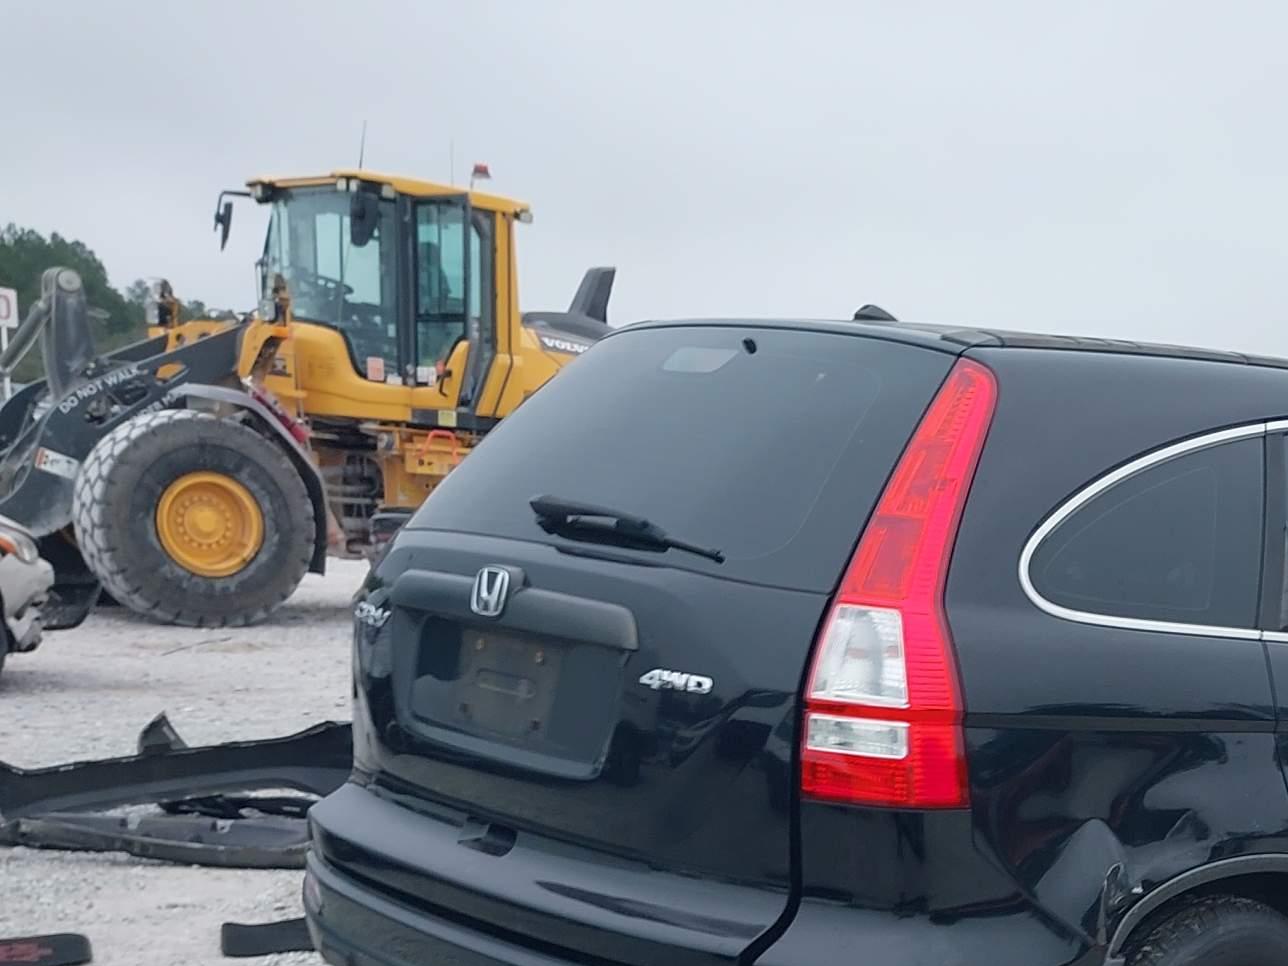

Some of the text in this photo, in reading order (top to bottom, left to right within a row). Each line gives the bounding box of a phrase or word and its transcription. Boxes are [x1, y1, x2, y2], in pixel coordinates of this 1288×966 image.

[541, 337, 589, 353] VOLV
[59, 366, 139, 415] DO NOT WALK
[639, 668, 714, 695] 4WD
